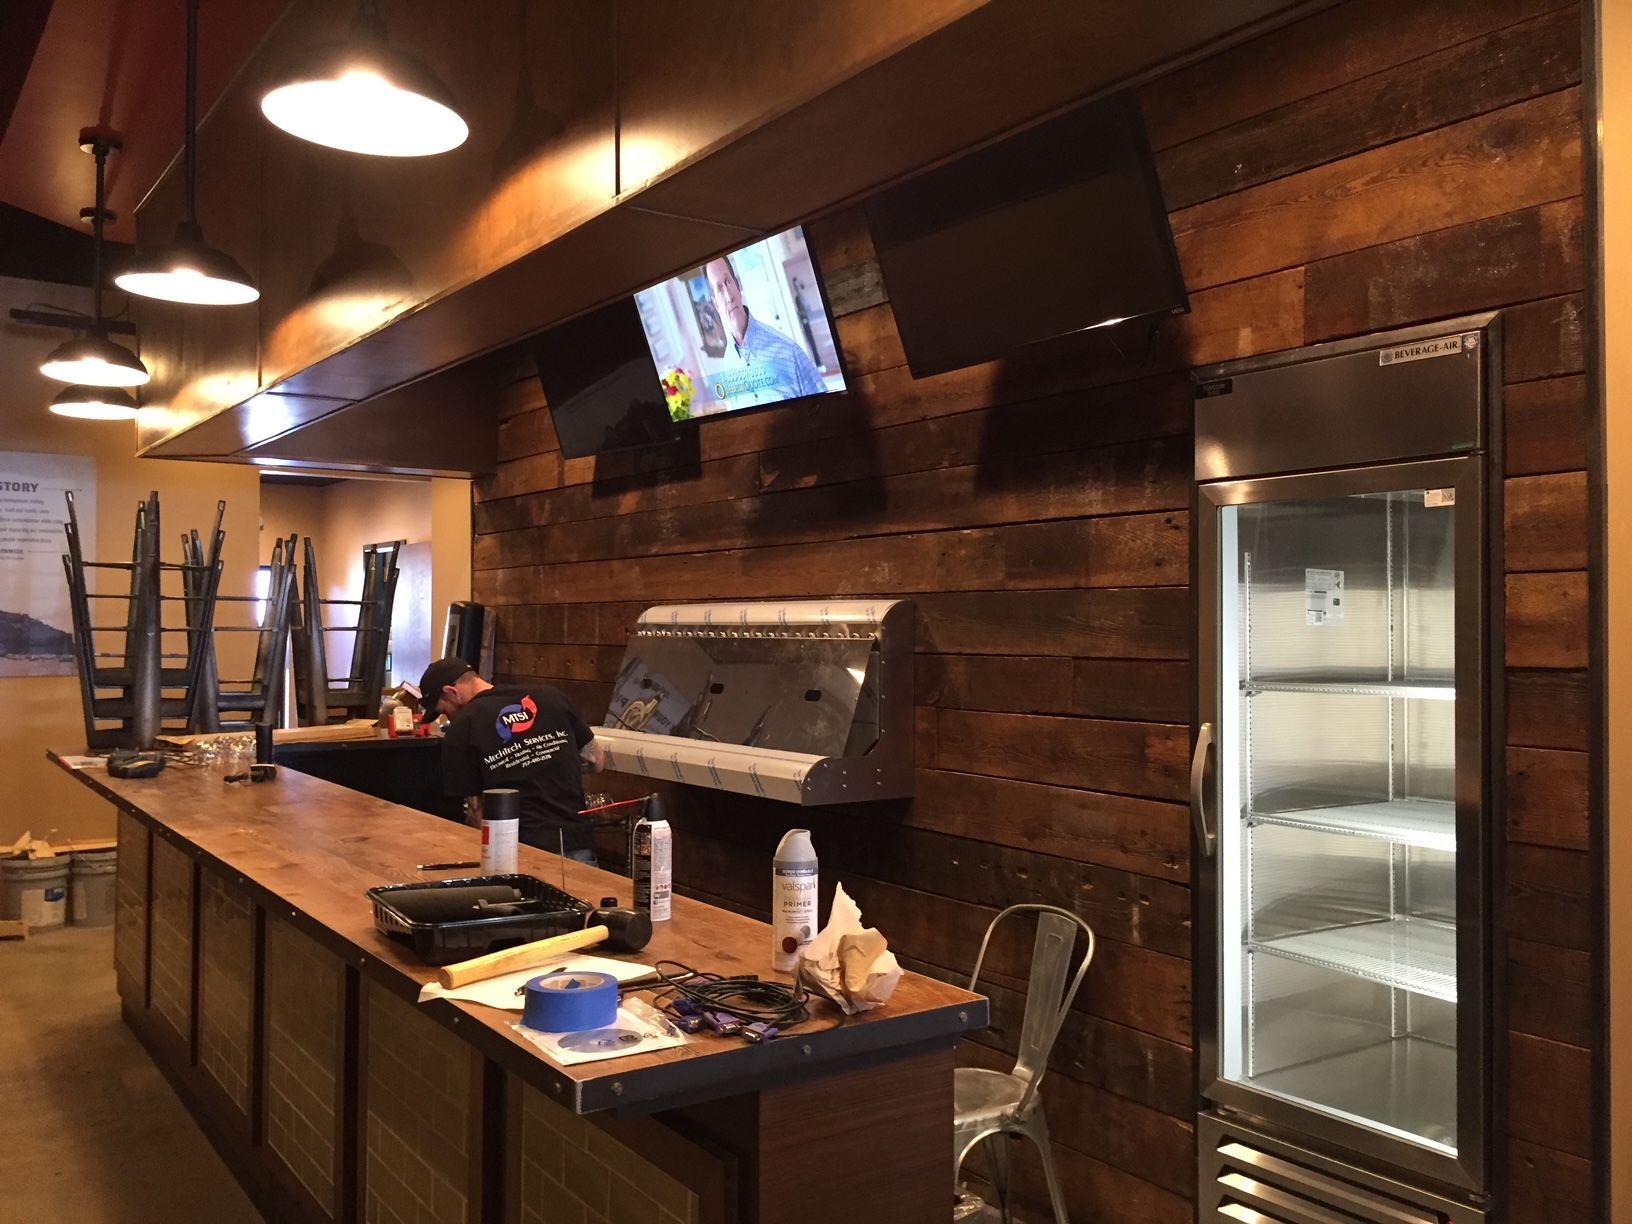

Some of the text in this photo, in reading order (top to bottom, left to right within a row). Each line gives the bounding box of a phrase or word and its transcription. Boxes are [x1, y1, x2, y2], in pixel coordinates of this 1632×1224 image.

[1394, 340, 1458, 359] BEVERAGE-AIR
[502, 712, 528, 725] MTSI
[781, 880, 815, 892] valspar
